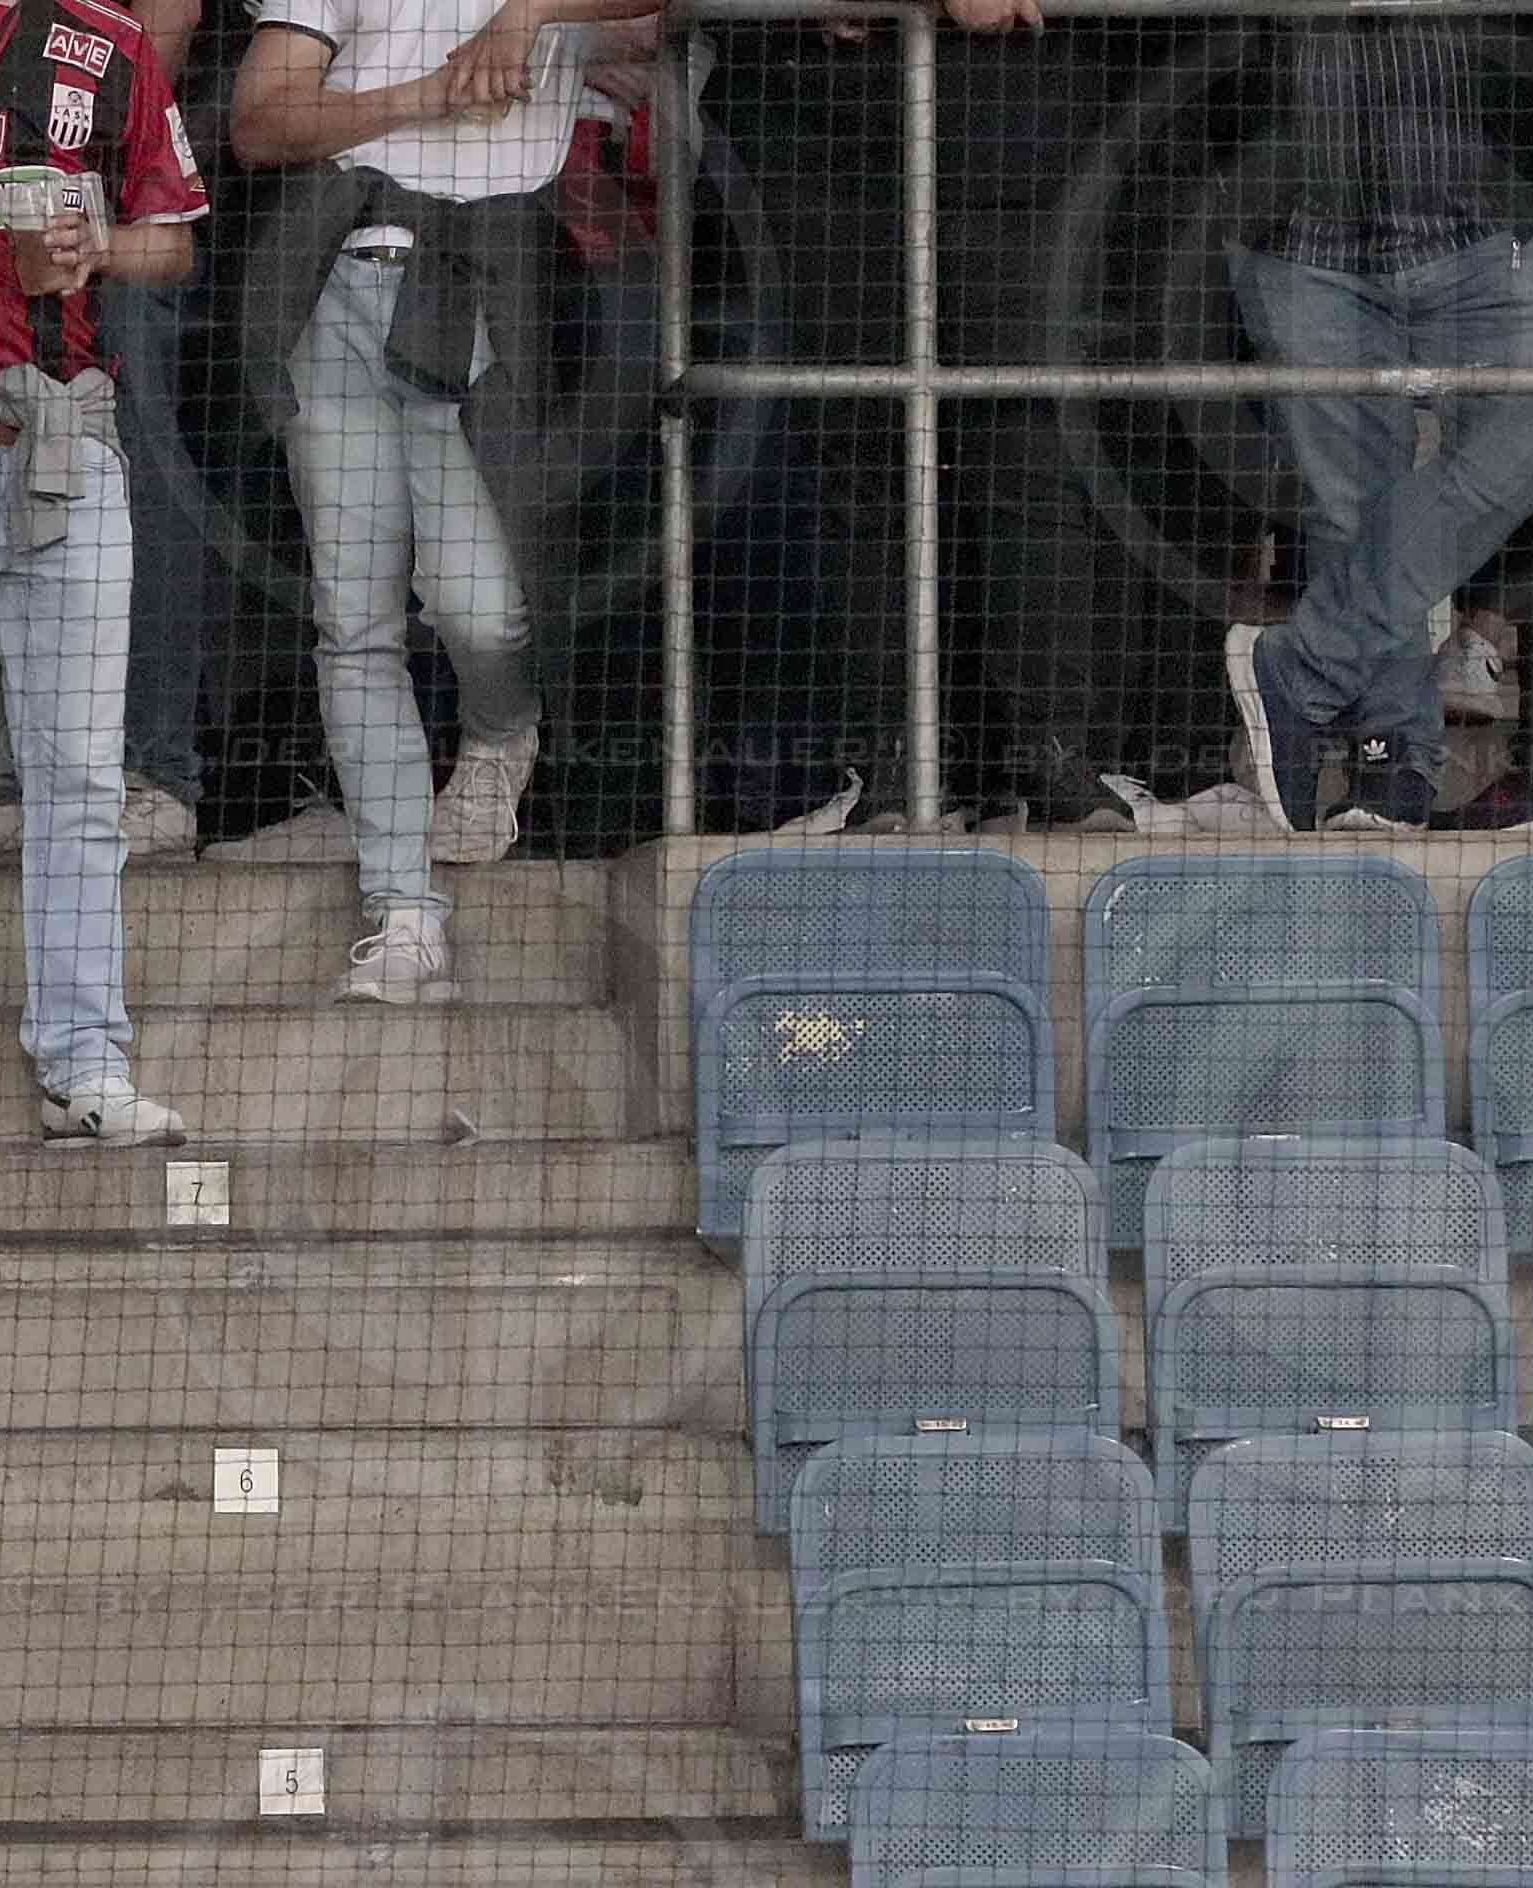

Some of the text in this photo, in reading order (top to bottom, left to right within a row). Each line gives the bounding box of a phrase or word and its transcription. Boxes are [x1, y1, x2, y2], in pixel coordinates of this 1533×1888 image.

[50, 32, 110, 66] AVE
[190, 1181, 204, 1206] 7
[240, 1468, 254, 1494] 6
[285, 1769, 299, 1795] 5
